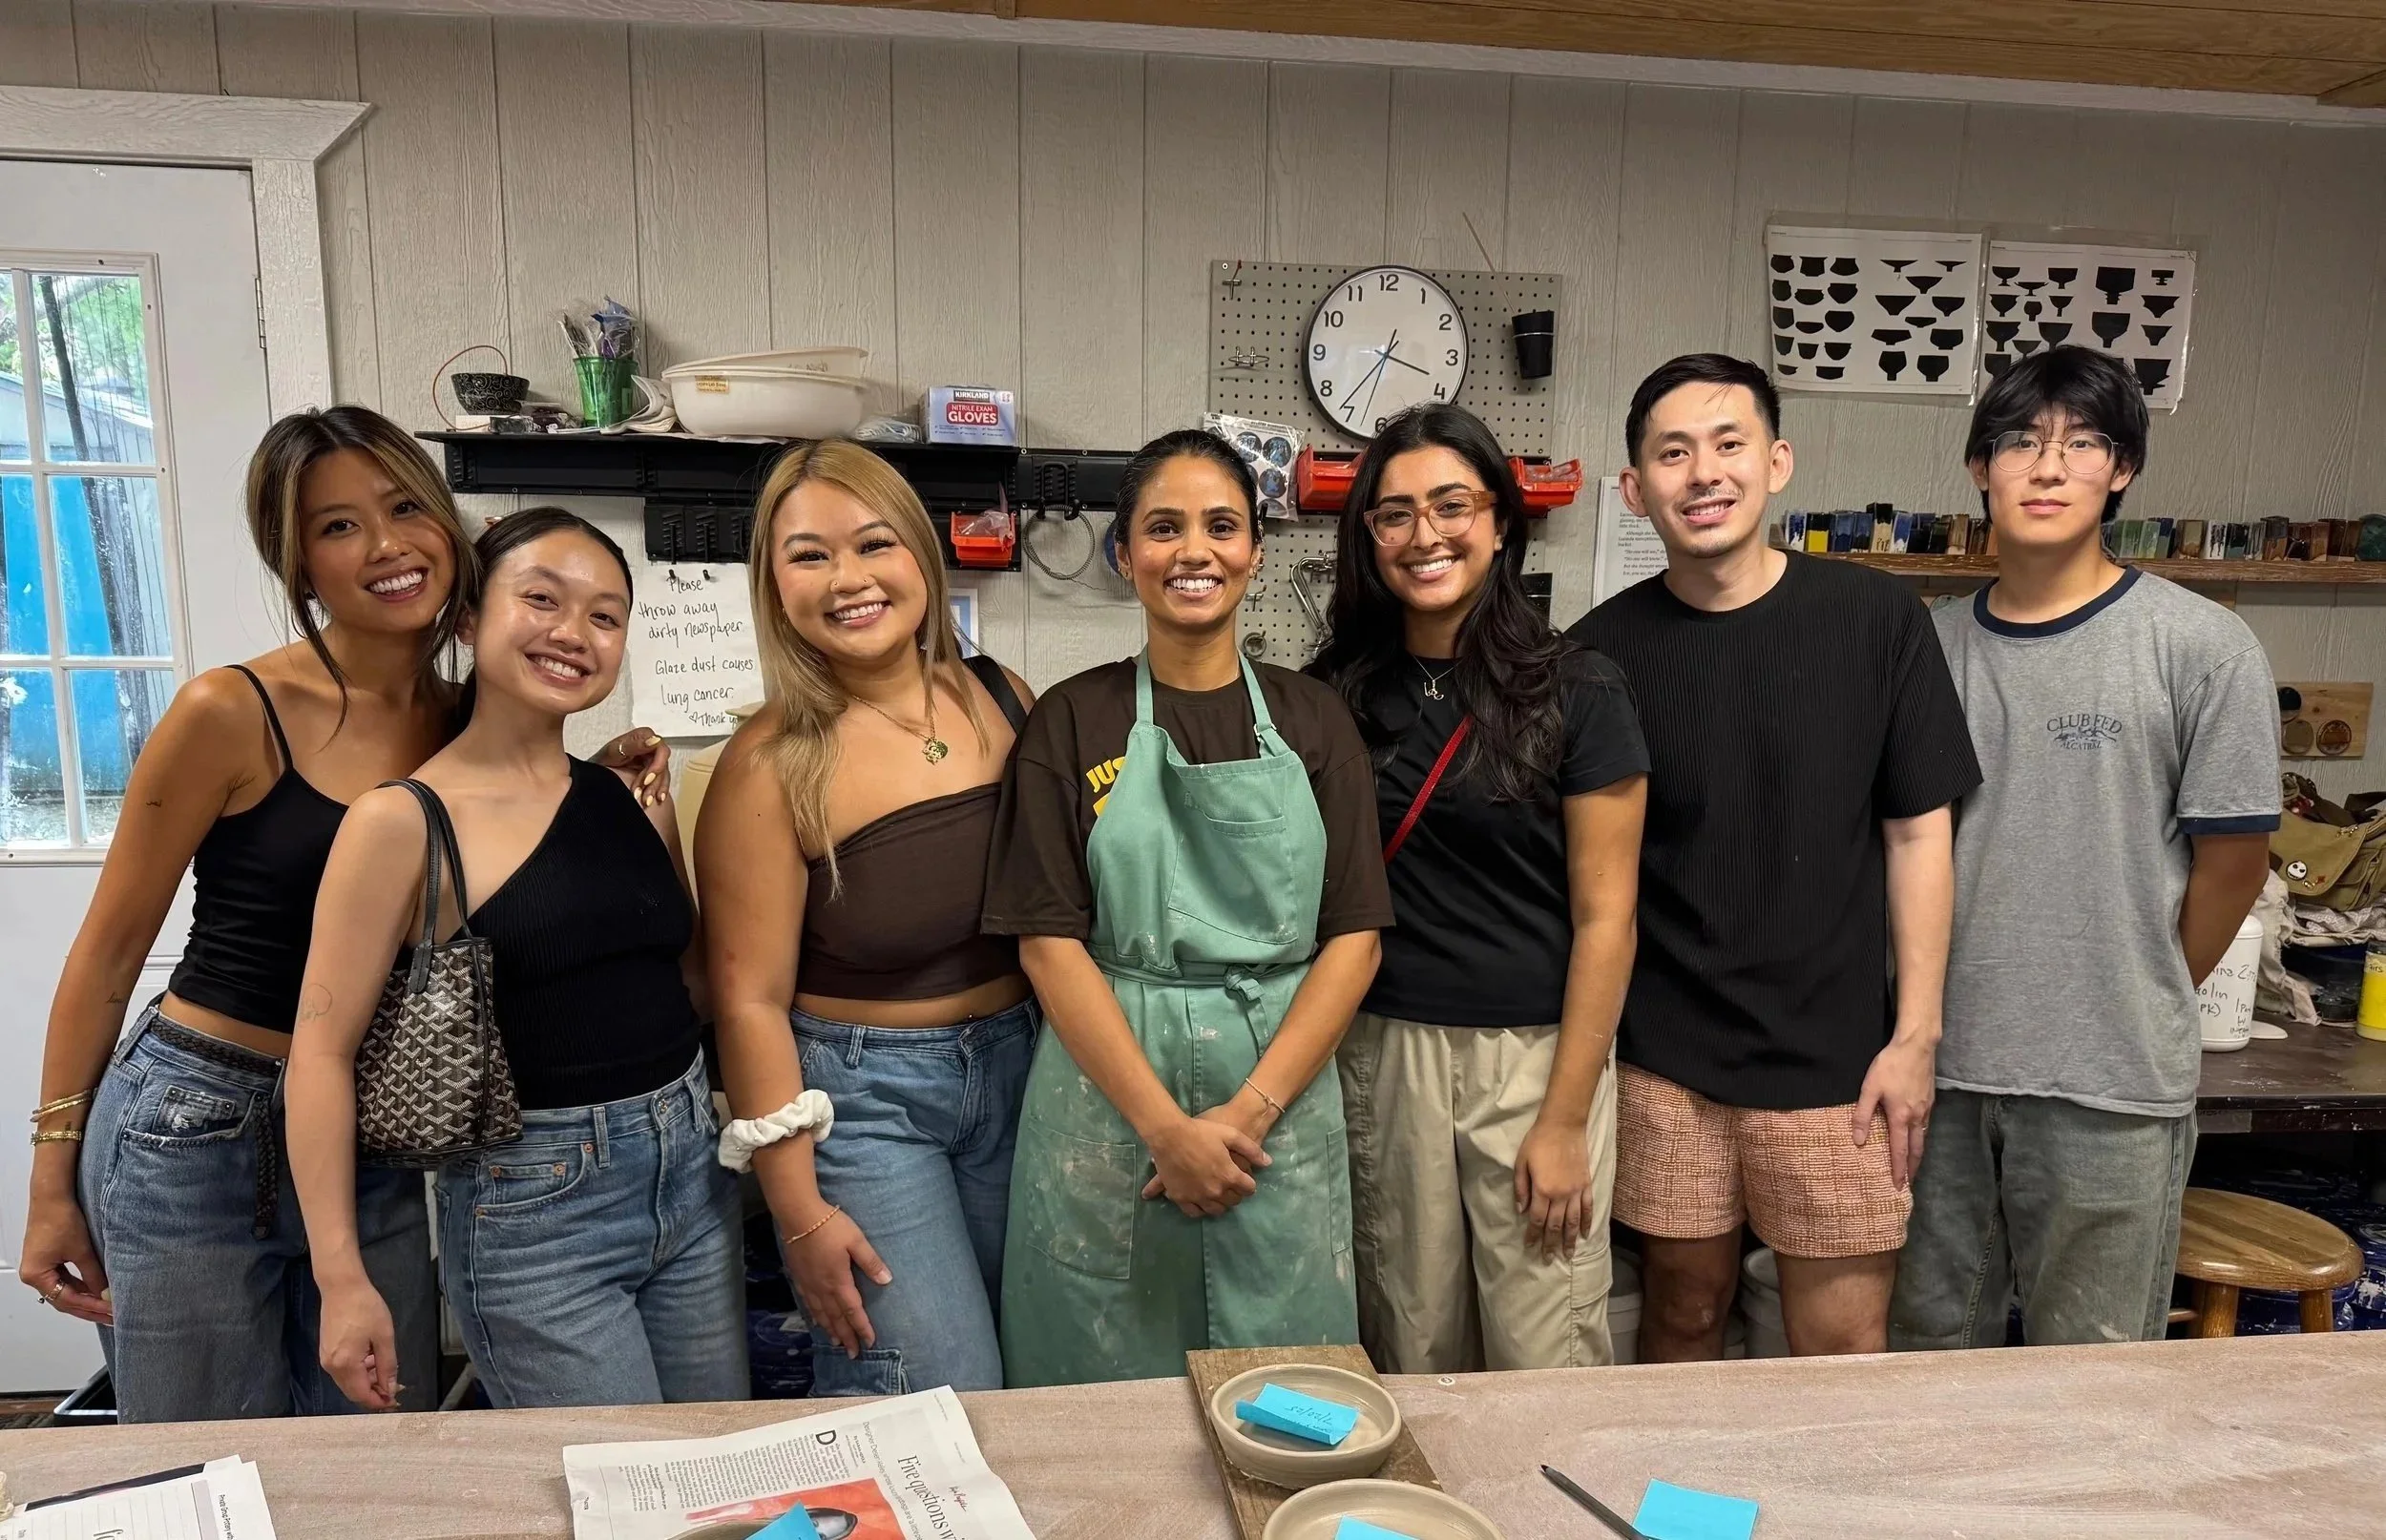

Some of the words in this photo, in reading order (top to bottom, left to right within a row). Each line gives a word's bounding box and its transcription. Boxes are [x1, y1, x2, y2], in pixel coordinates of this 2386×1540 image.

[1379, 274, 1399, 291] 12
[1348, 284, 1363, 302] 11
[1420, 286, 1426, 304] 1
[1324, 310, 1344, 327] 10
[1438, 313, 1453, 331] 2
[1312, 343, 1327, 362] 9
[1445, 348, 1459, 366] 3
[1320, 380, 1332, 397] 8
[1434, 383, 1446, 401] 4
[948, 410, 997, 425] GLOVES
[1343, 406, 1355, 423] 7
[1374, 416, 1388, 433] 6
[666, 576, 703, 593] Please
[638, 601, 677, 620] throw
[683, 602, 718, 622] away
[649, 623, 680, 649] dirty
[655, 659, 687, 676] Glaze
[691, 656, 717, 673] dust
[722, 657, 754, 672] causes
[660, 684, 689, 713] lung
[700, 712, 725, 726] Thank
[2046, 714, 2090, 732] CLUB
[2093, 714, 2123, 734] FED
[897, 1455, 921, 1480] Five
[905, 1480, 950, 1530] questions
